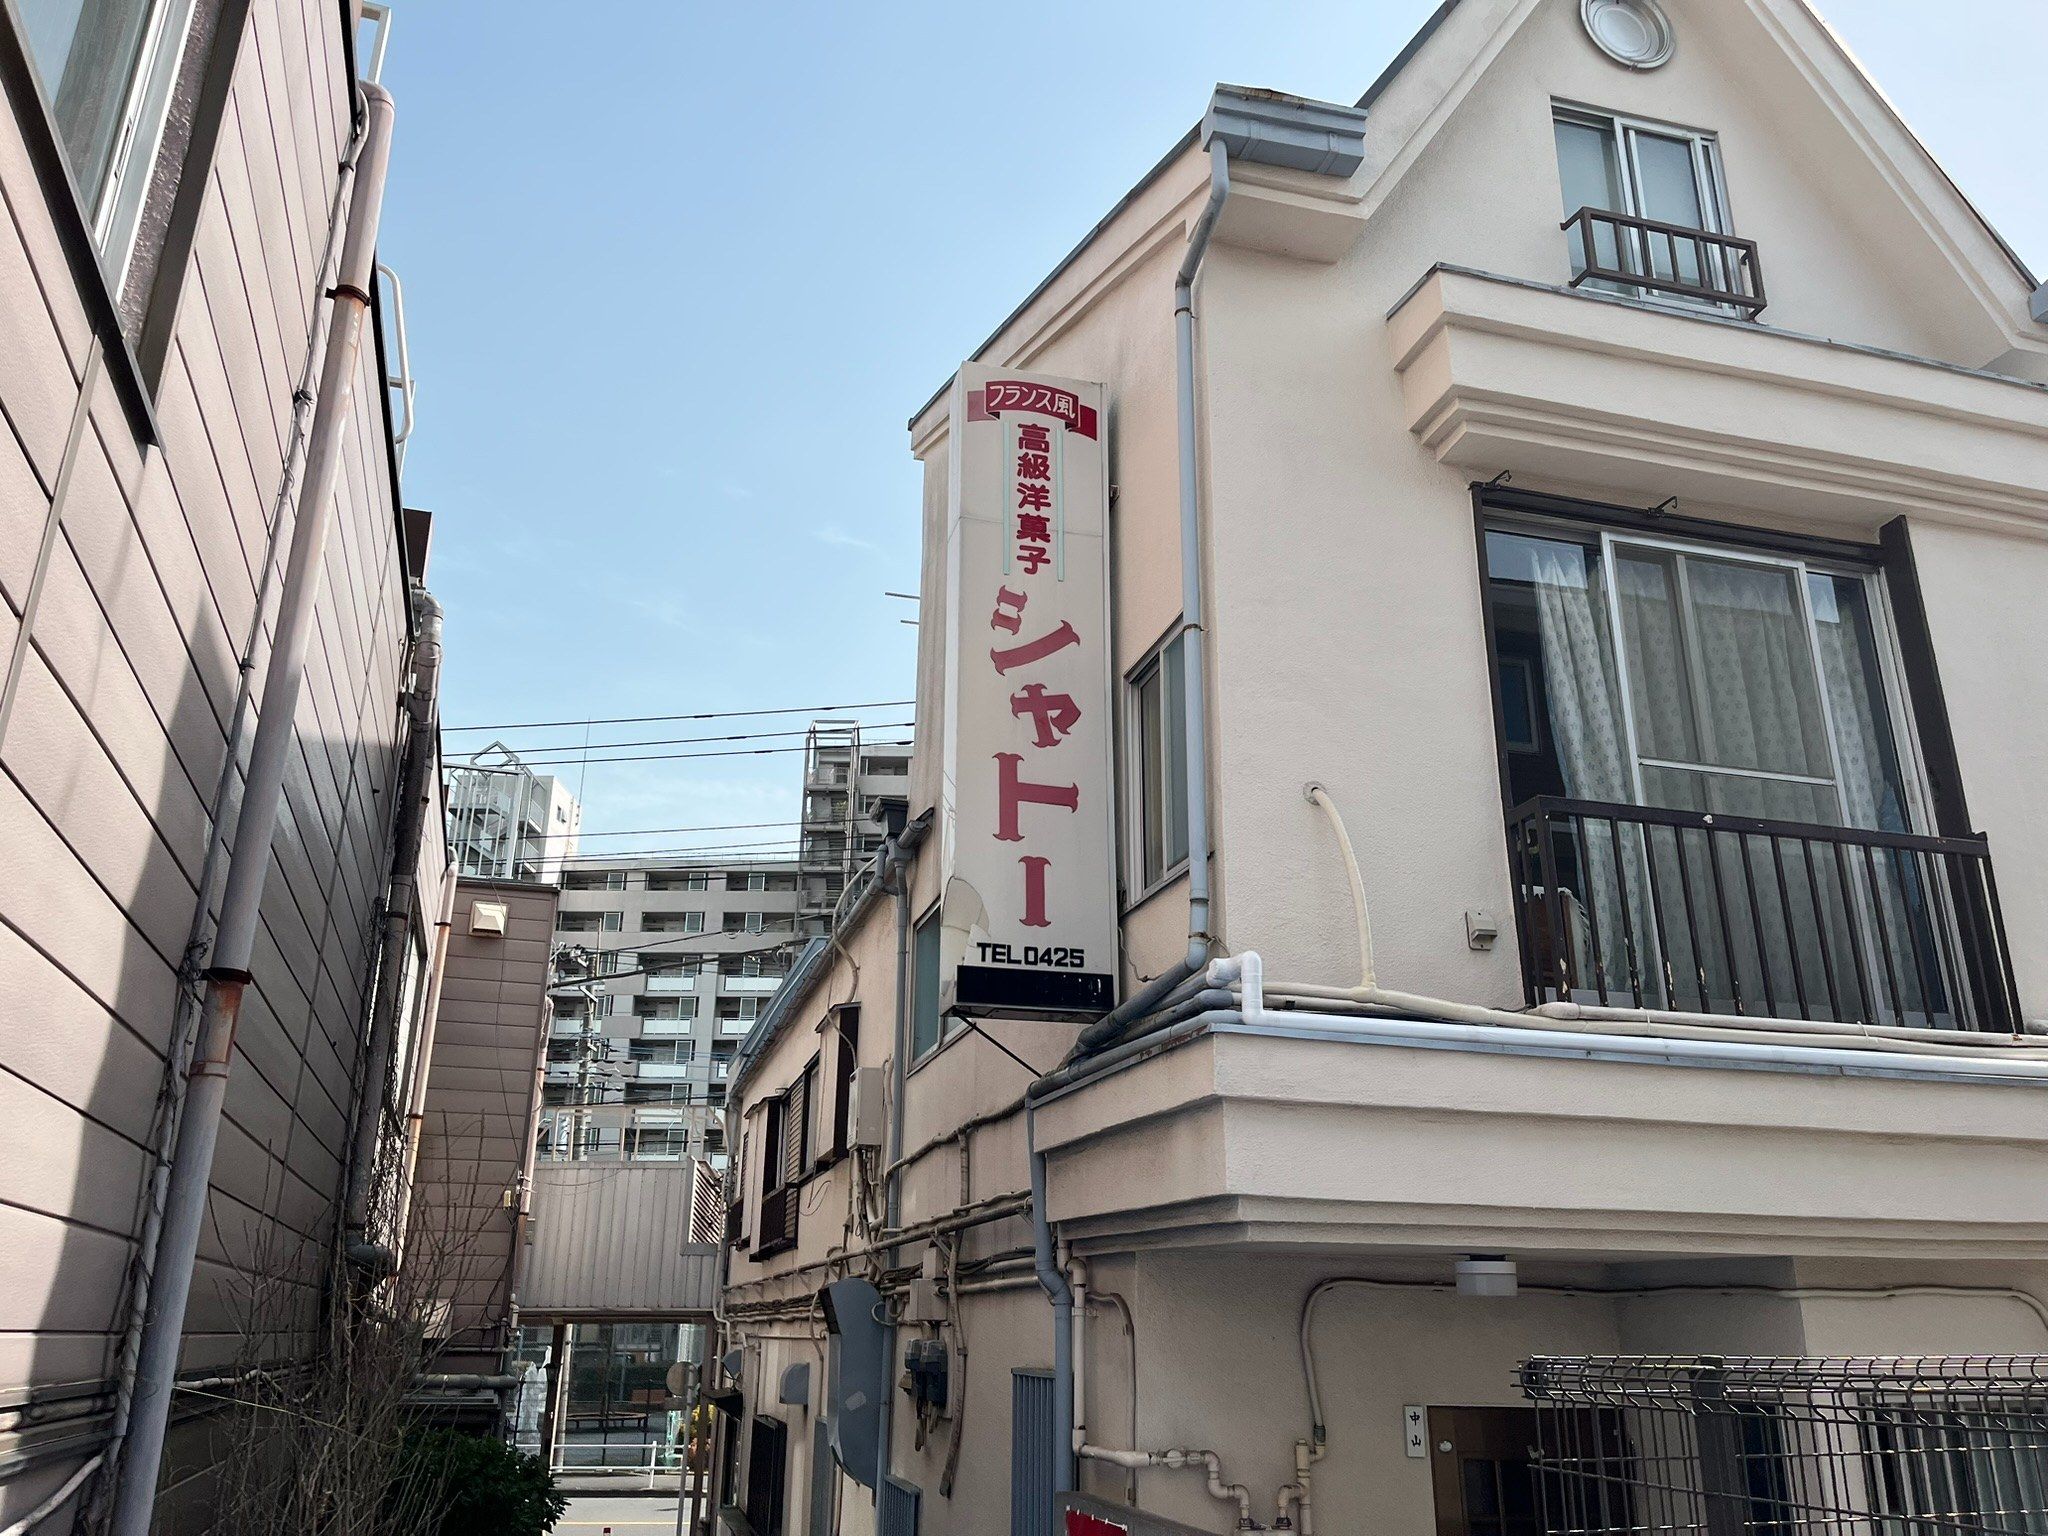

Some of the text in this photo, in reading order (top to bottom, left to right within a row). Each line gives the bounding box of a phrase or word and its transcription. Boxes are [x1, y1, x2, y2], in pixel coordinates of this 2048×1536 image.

[989, 385, 1076, 419] フランス風
[1016, 422, 1052, 576] 高級洋菓子
[989, 584, 1082, 928] シャトー
[1409, 1411, 1422, 1448] 中山
